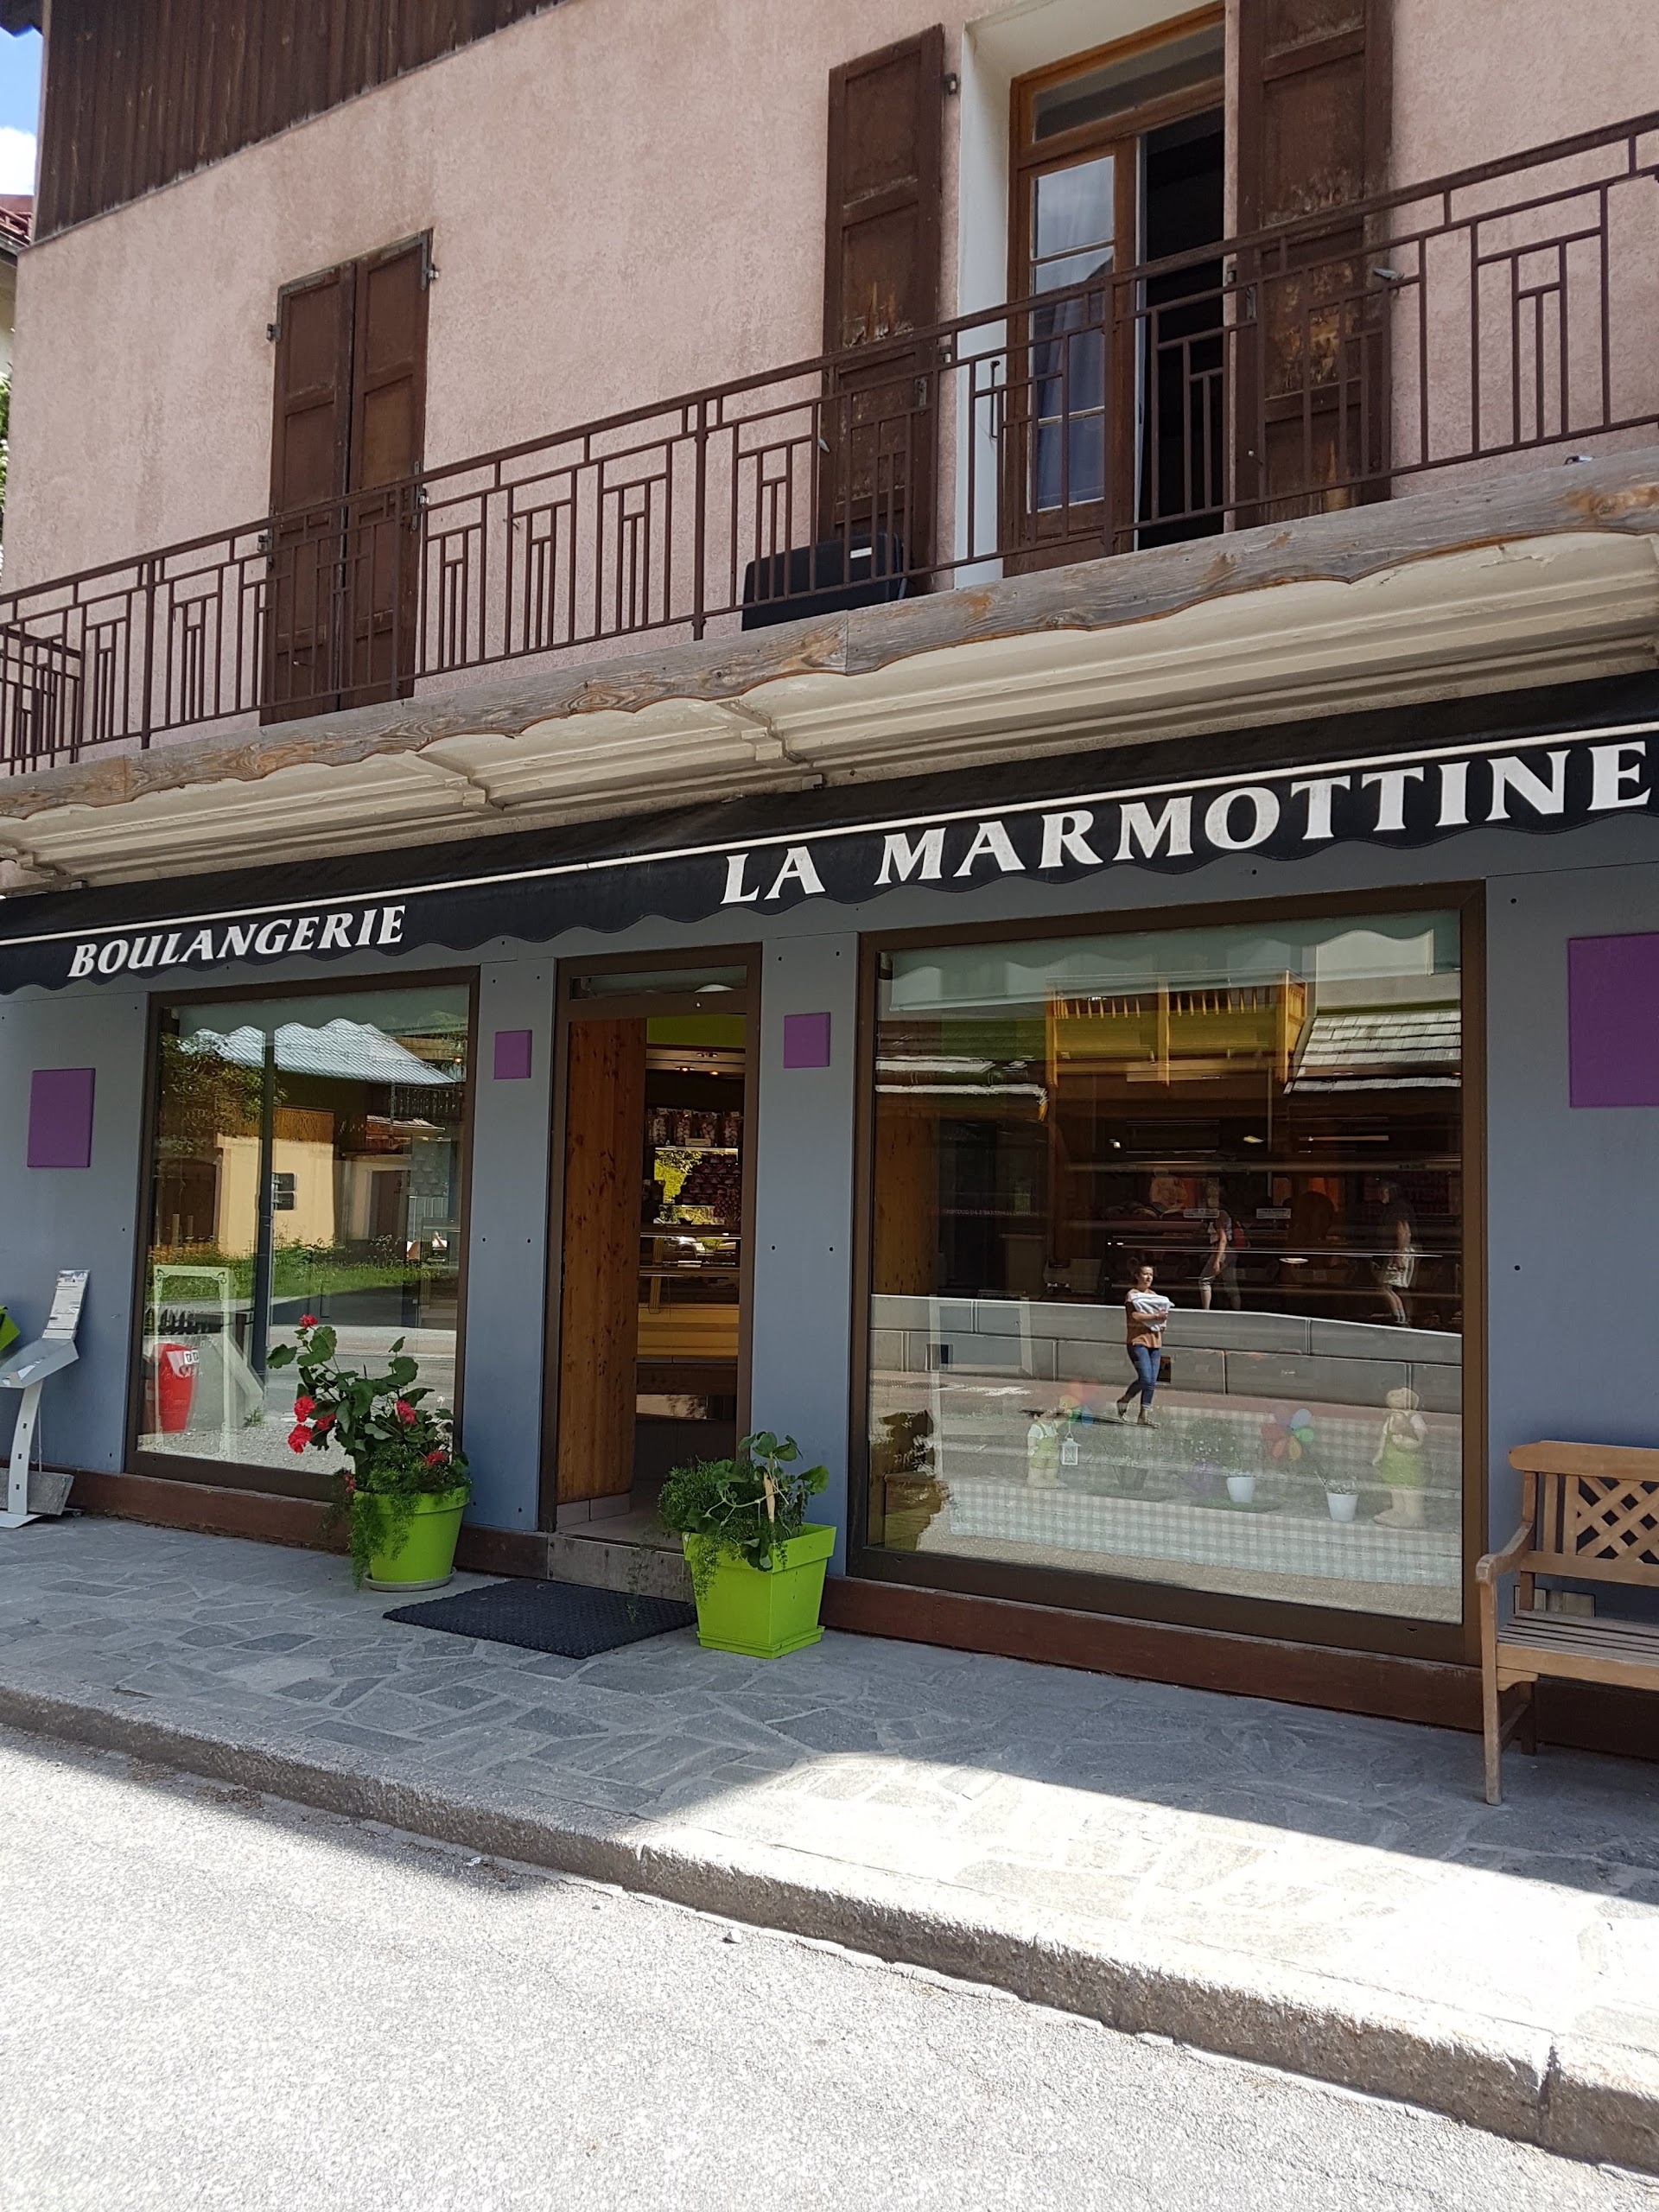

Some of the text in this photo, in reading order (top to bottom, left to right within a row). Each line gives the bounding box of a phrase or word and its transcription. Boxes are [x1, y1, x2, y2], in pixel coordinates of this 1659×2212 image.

[67, 741, 1652, 977] BOULANGERIE LA MARMOTTINE
